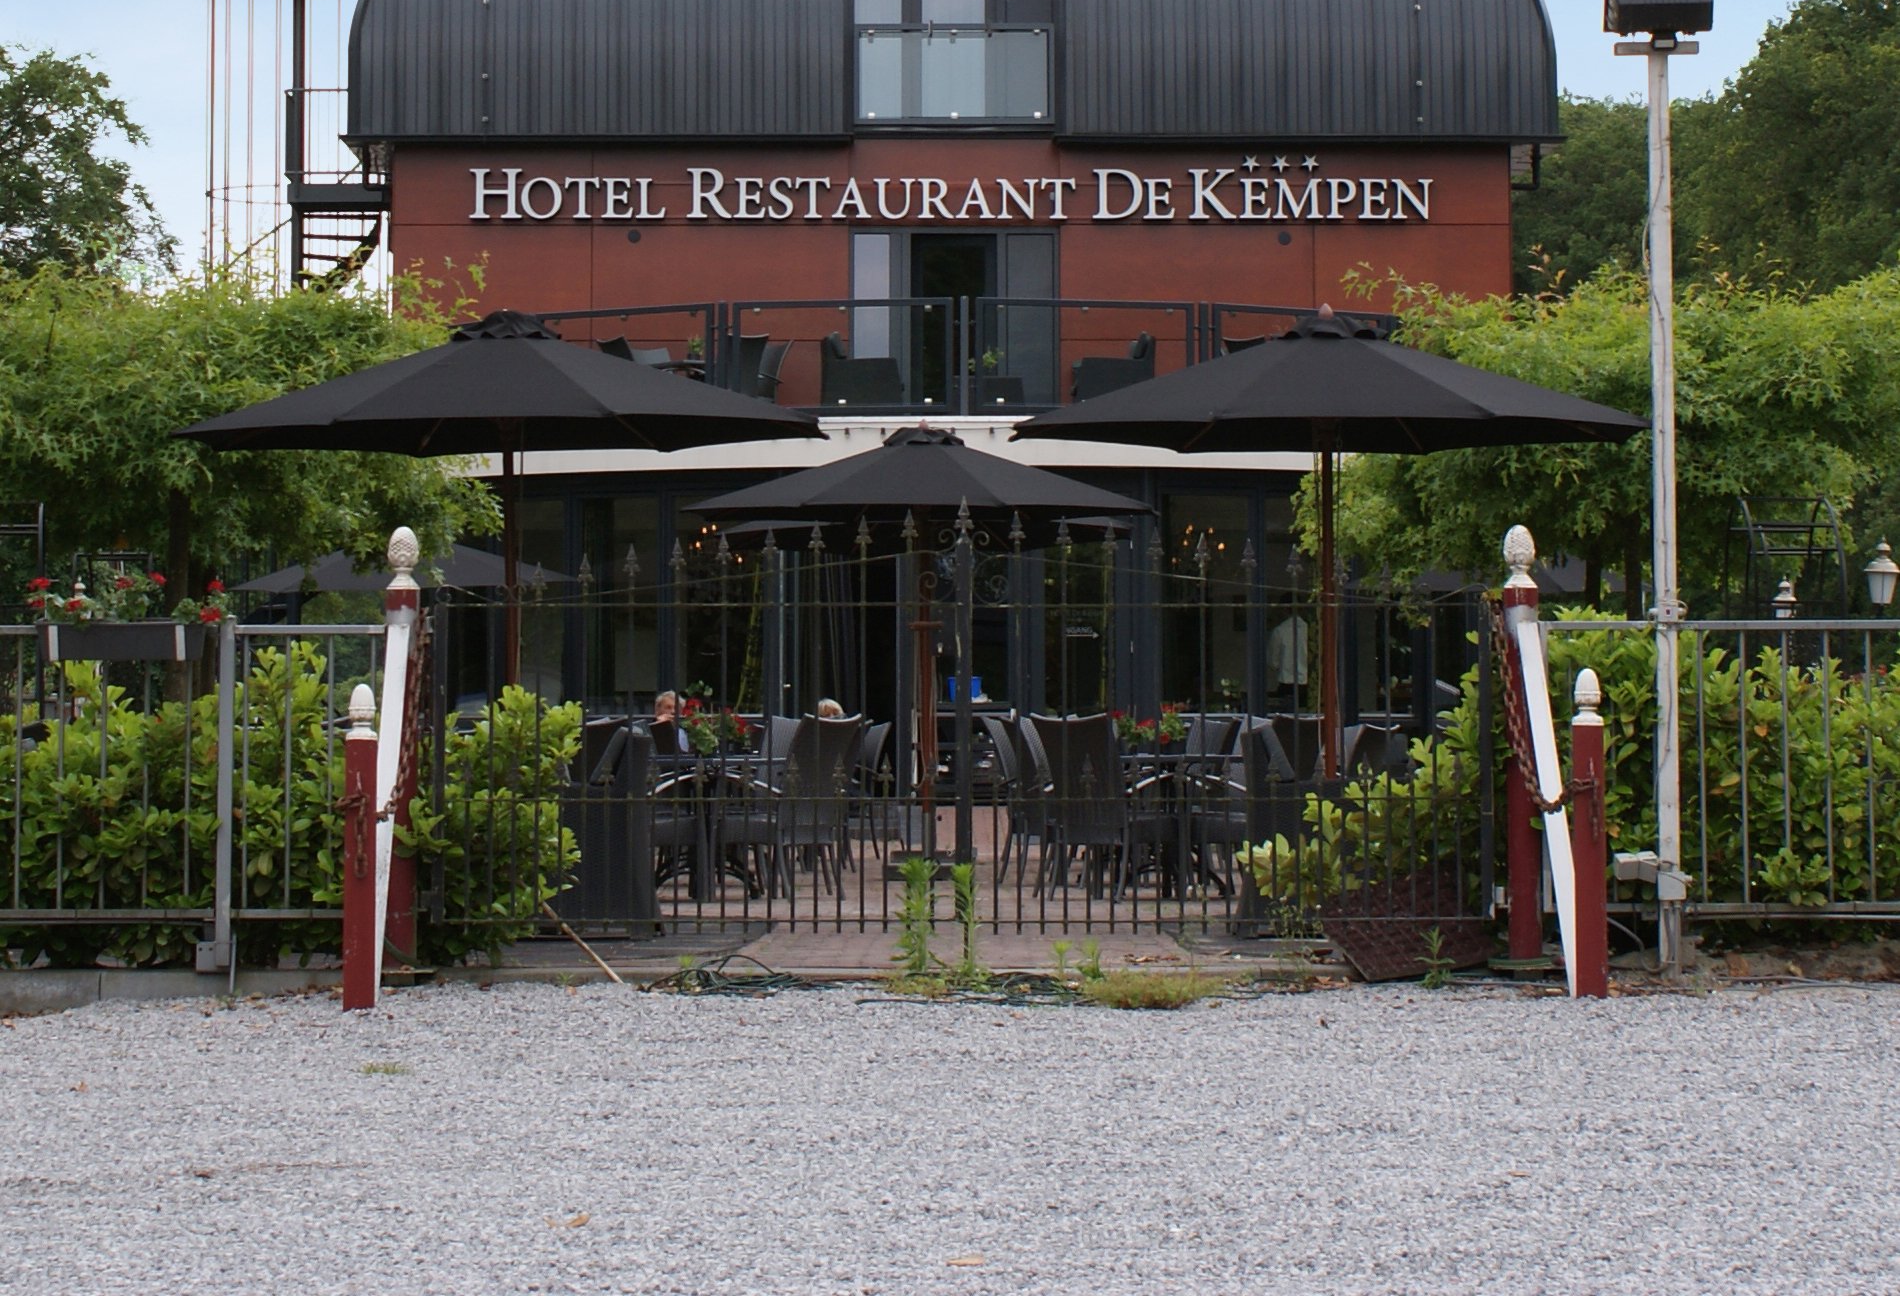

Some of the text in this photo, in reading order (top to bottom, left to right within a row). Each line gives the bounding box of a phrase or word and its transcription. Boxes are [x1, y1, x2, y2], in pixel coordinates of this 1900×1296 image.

[468, 167, 1435, 220] HOTEL RESTAURANT DE KEMPEN
